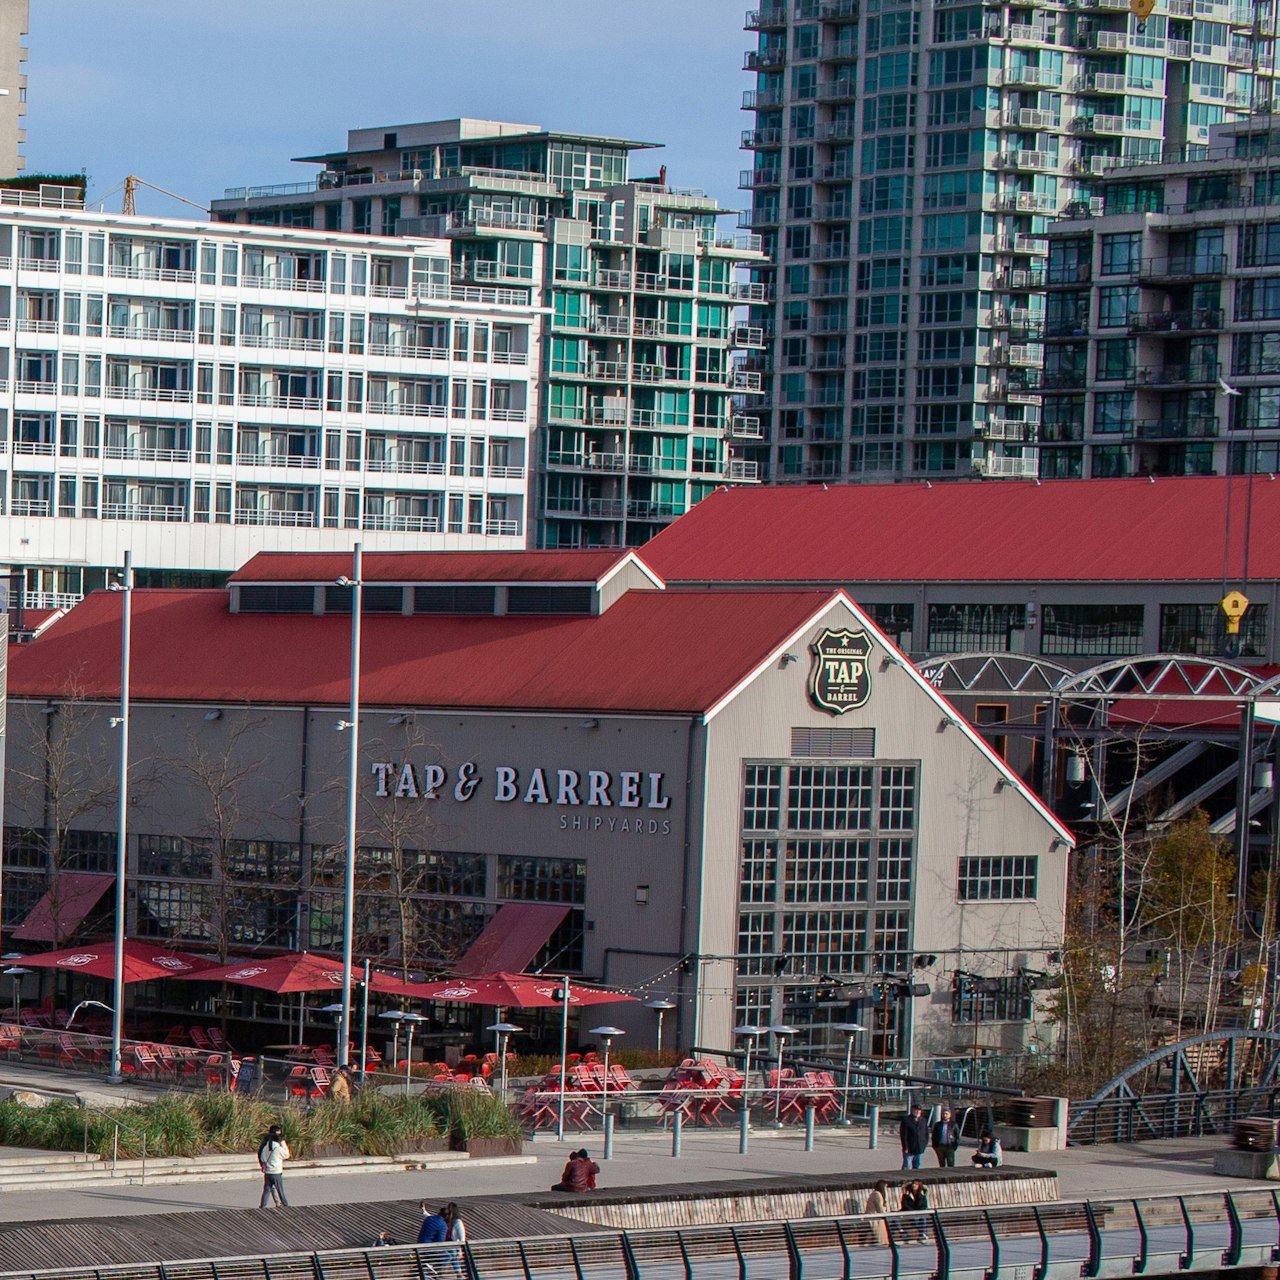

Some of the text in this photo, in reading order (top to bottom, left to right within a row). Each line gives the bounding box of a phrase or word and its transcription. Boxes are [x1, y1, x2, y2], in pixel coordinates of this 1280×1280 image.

[837, 647, 863, 655] ORIGINAL
[825, 661, 863, 684] TAP
[826, 693, 858, 702] BARREL
[371, 762, 671, 809] TAP & BARREL
[559, 815, 671, 835] SHIPYARDS
